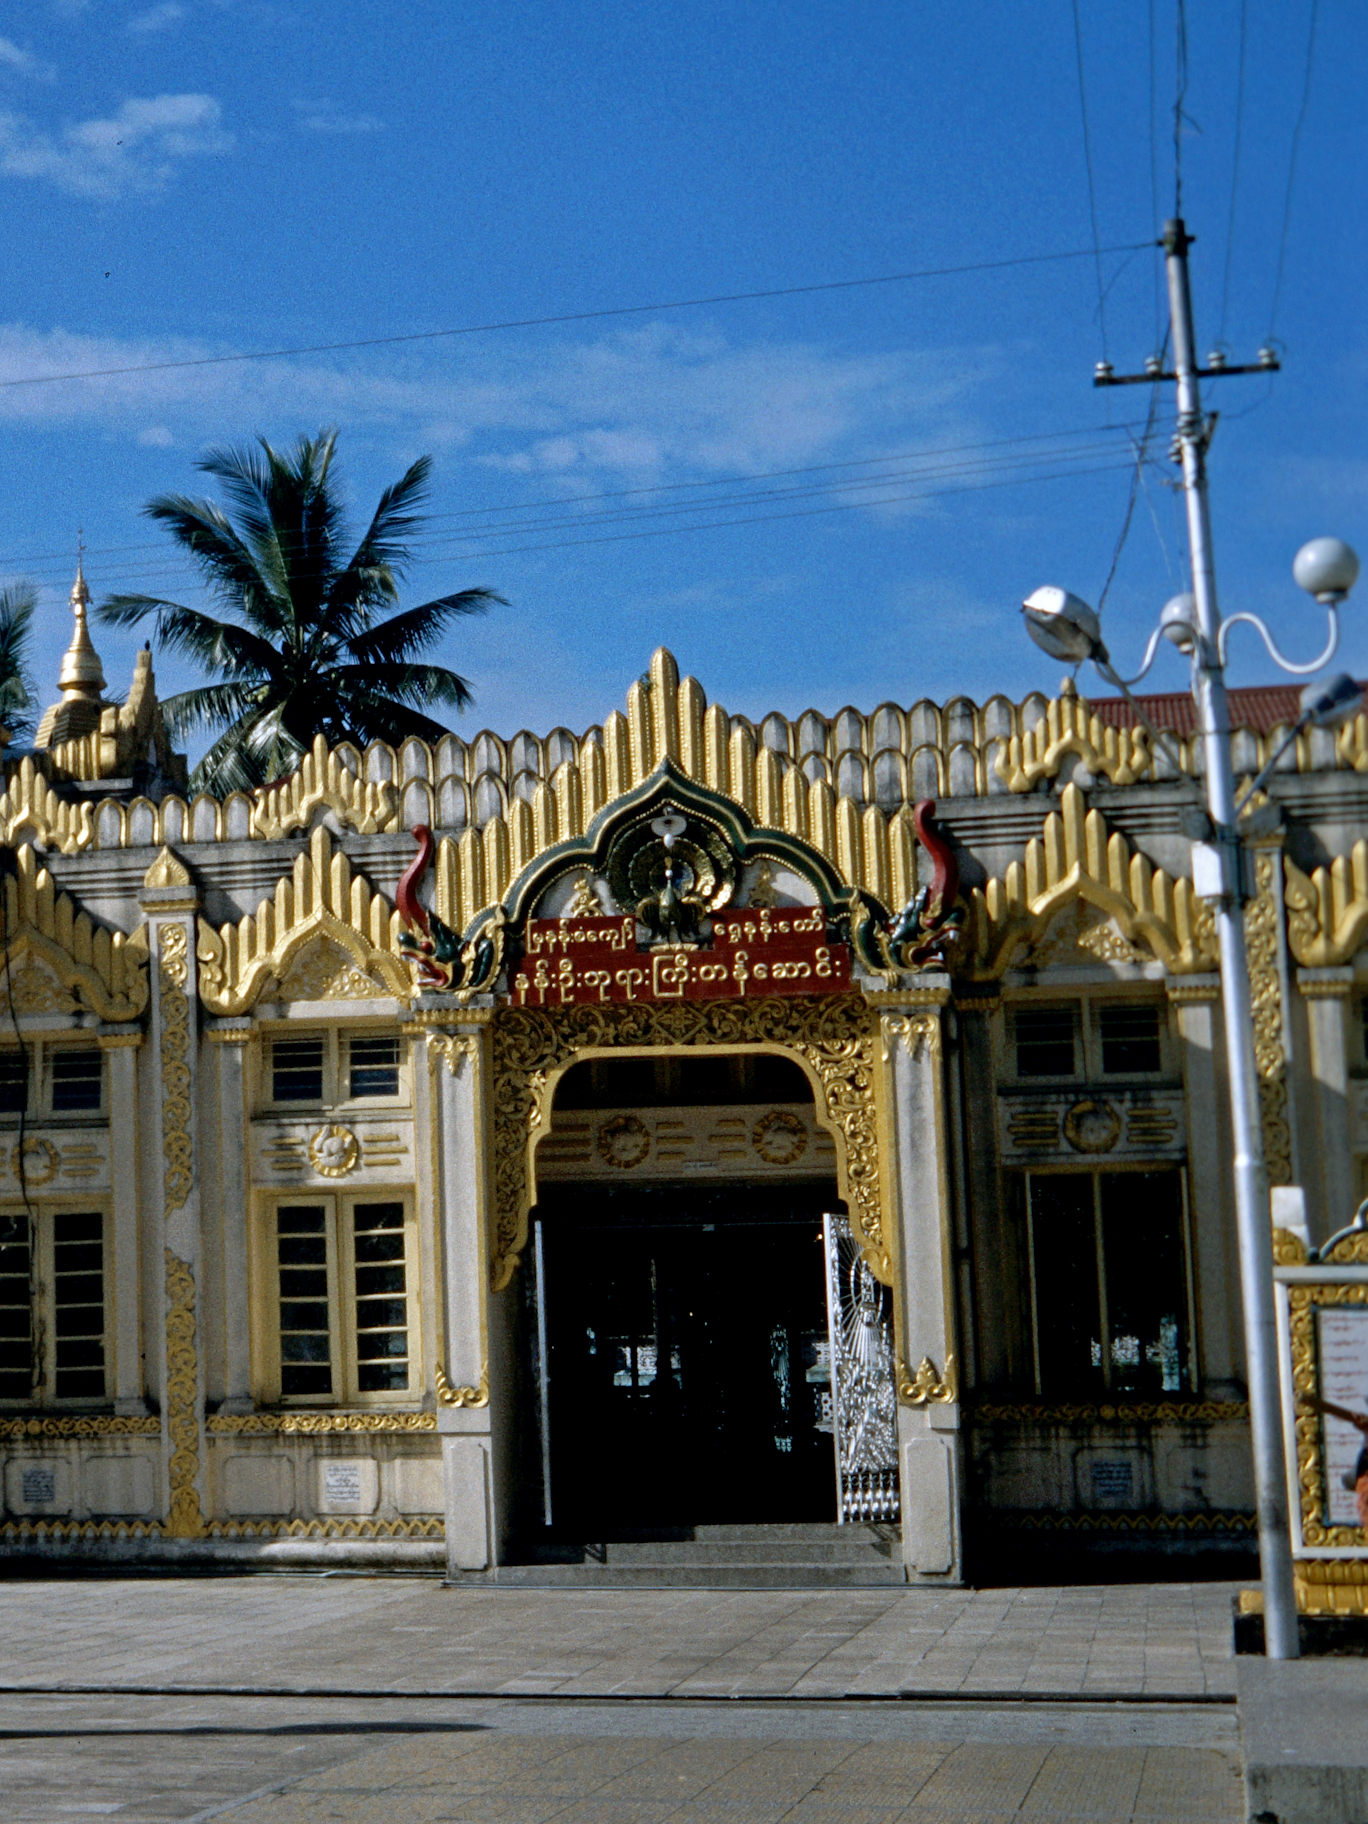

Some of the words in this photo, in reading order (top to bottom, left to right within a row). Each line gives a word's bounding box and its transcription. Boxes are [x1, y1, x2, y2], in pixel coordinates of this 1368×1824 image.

[527, 917, 634, 954] မြနန်းစံကျော်
[714, 908, 824, 943] ရွှေနန်းတော်
